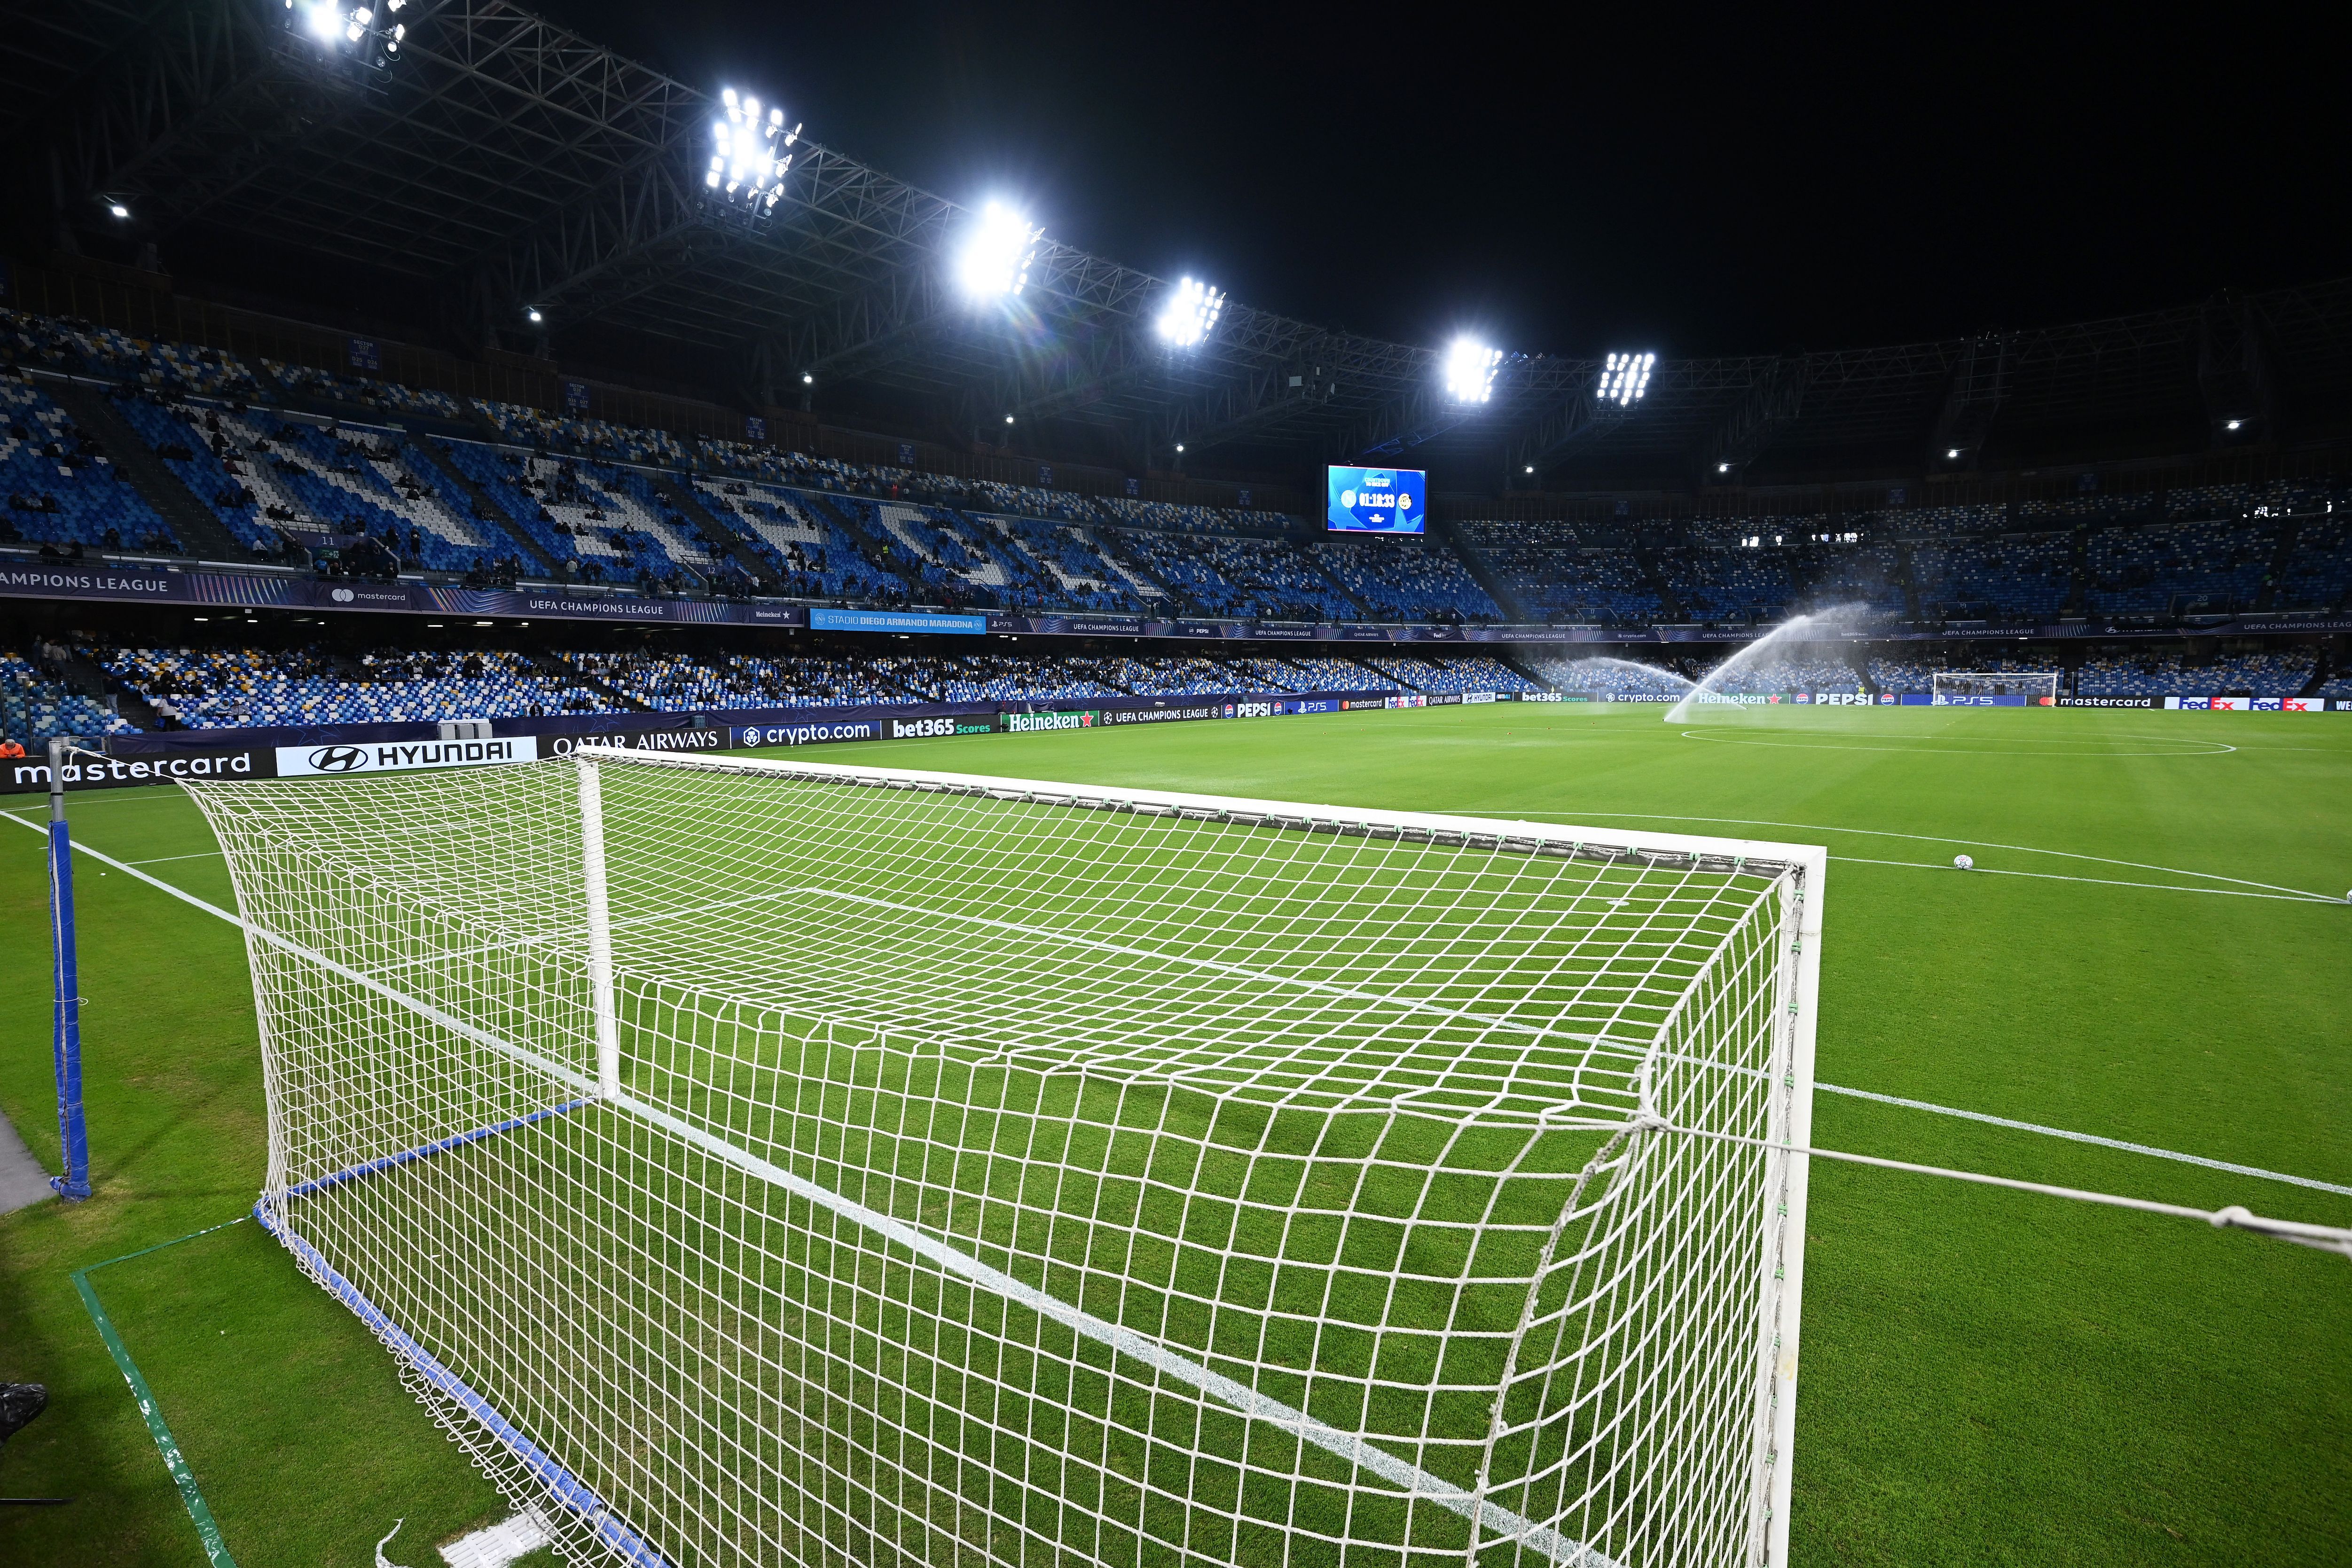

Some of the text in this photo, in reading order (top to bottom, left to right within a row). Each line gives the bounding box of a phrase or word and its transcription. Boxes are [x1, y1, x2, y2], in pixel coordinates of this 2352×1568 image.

[322, 536, 334, 545] 11
[0, 572, 168, 592] AMPIONS LEAGUE
[530, 600, 663, 614] UEFA CHAMPIONS LEAGUE
[828, 615, 972, 629] STADIO DIEGO ARMANDO MARADONA
[1389, 697, 1404, 708] FedEx
[1409, 696, 1424, 707] FedEx
[1429, 695, 1460, 706] QATAR AIRWAYS
[1522, 692, 1561, 702] bet365
[1618, 693, 1680, 703] crypto.com
[1698, 693, 1766, 704] Heineken
[1816, 694, 1873, 706] PEPSI
[1953, 696, 1993, 705] PS5
[2060, 698, 2151, 707] mastercard
[1308, 702, 1326, 712] PS5
[1350, 699, 1382, 709] mastercard
[2179, 697, 2234, 710] FedEx
[2249, 698, 2308, 711] FedEx
[2336, 701, 2352, 710] WE
[1116, 708, 1208, 722] UEFA CHAMPIONS LEAGUE
[1238, 702, 1270, 718] PEPSI
[893, 718, 990, 738] bet365 Scores
[1009, 712, 1080, 732] Heineken
[767, 724, 870, 745] crypto.com
[553, 731, 718, 756] QATAR AIRWAYS
[378, 741, 512, 766] HYUNDAI
[15, 752, 251, 784] mastercard
